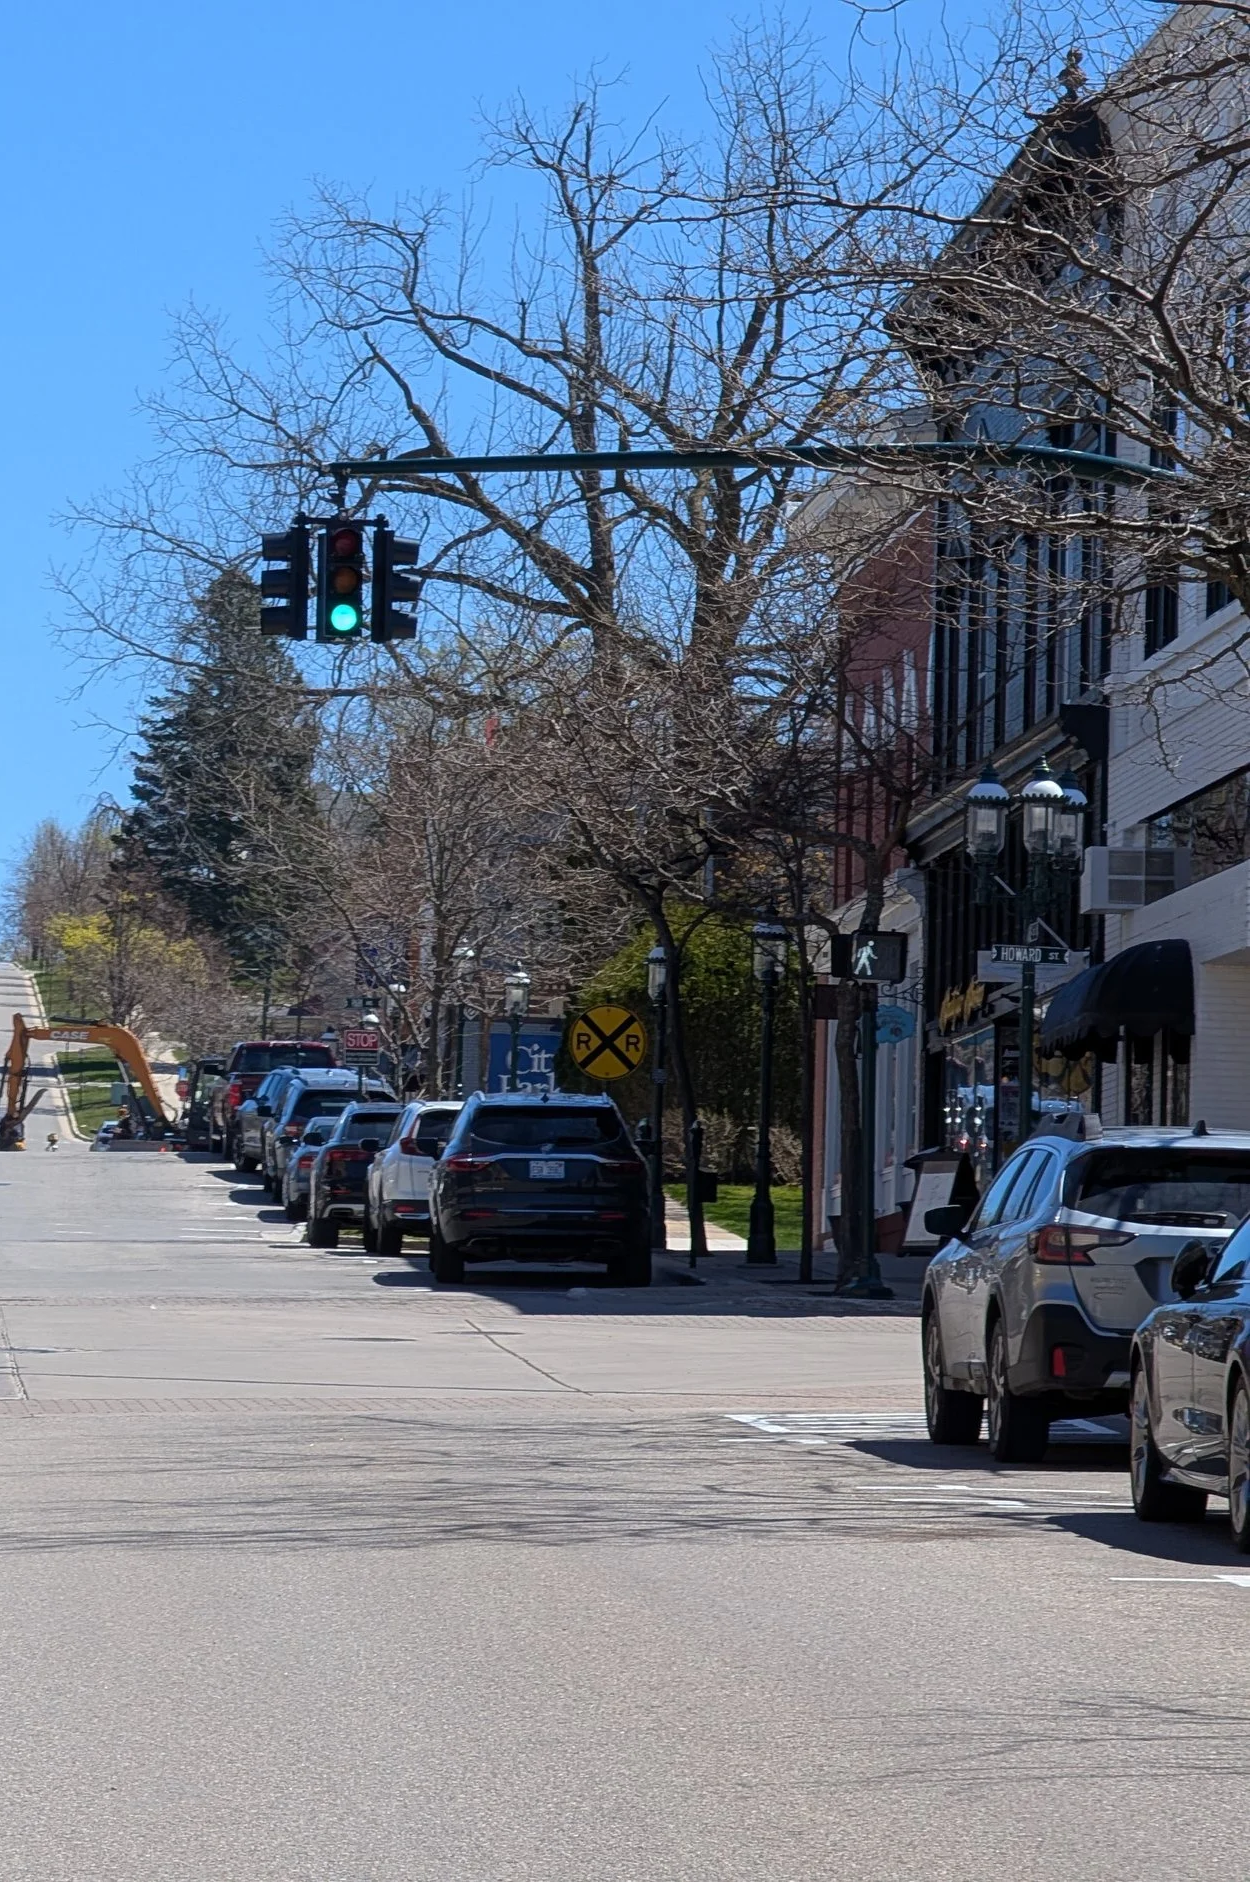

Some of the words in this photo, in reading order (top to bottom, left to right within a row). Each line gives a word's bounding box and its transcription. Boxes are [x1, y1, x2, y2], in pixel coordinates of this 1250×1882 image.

[1000, 946, 1042, 963] HOWARD
[50, 1030, 90, 1040] CASE
[347, 1033, 378, 1048] STOP
[576, 1032, 592, 1051] R
[625, 1034, 641, 1052] R
[505, 1043, 555, 1075] Cit
